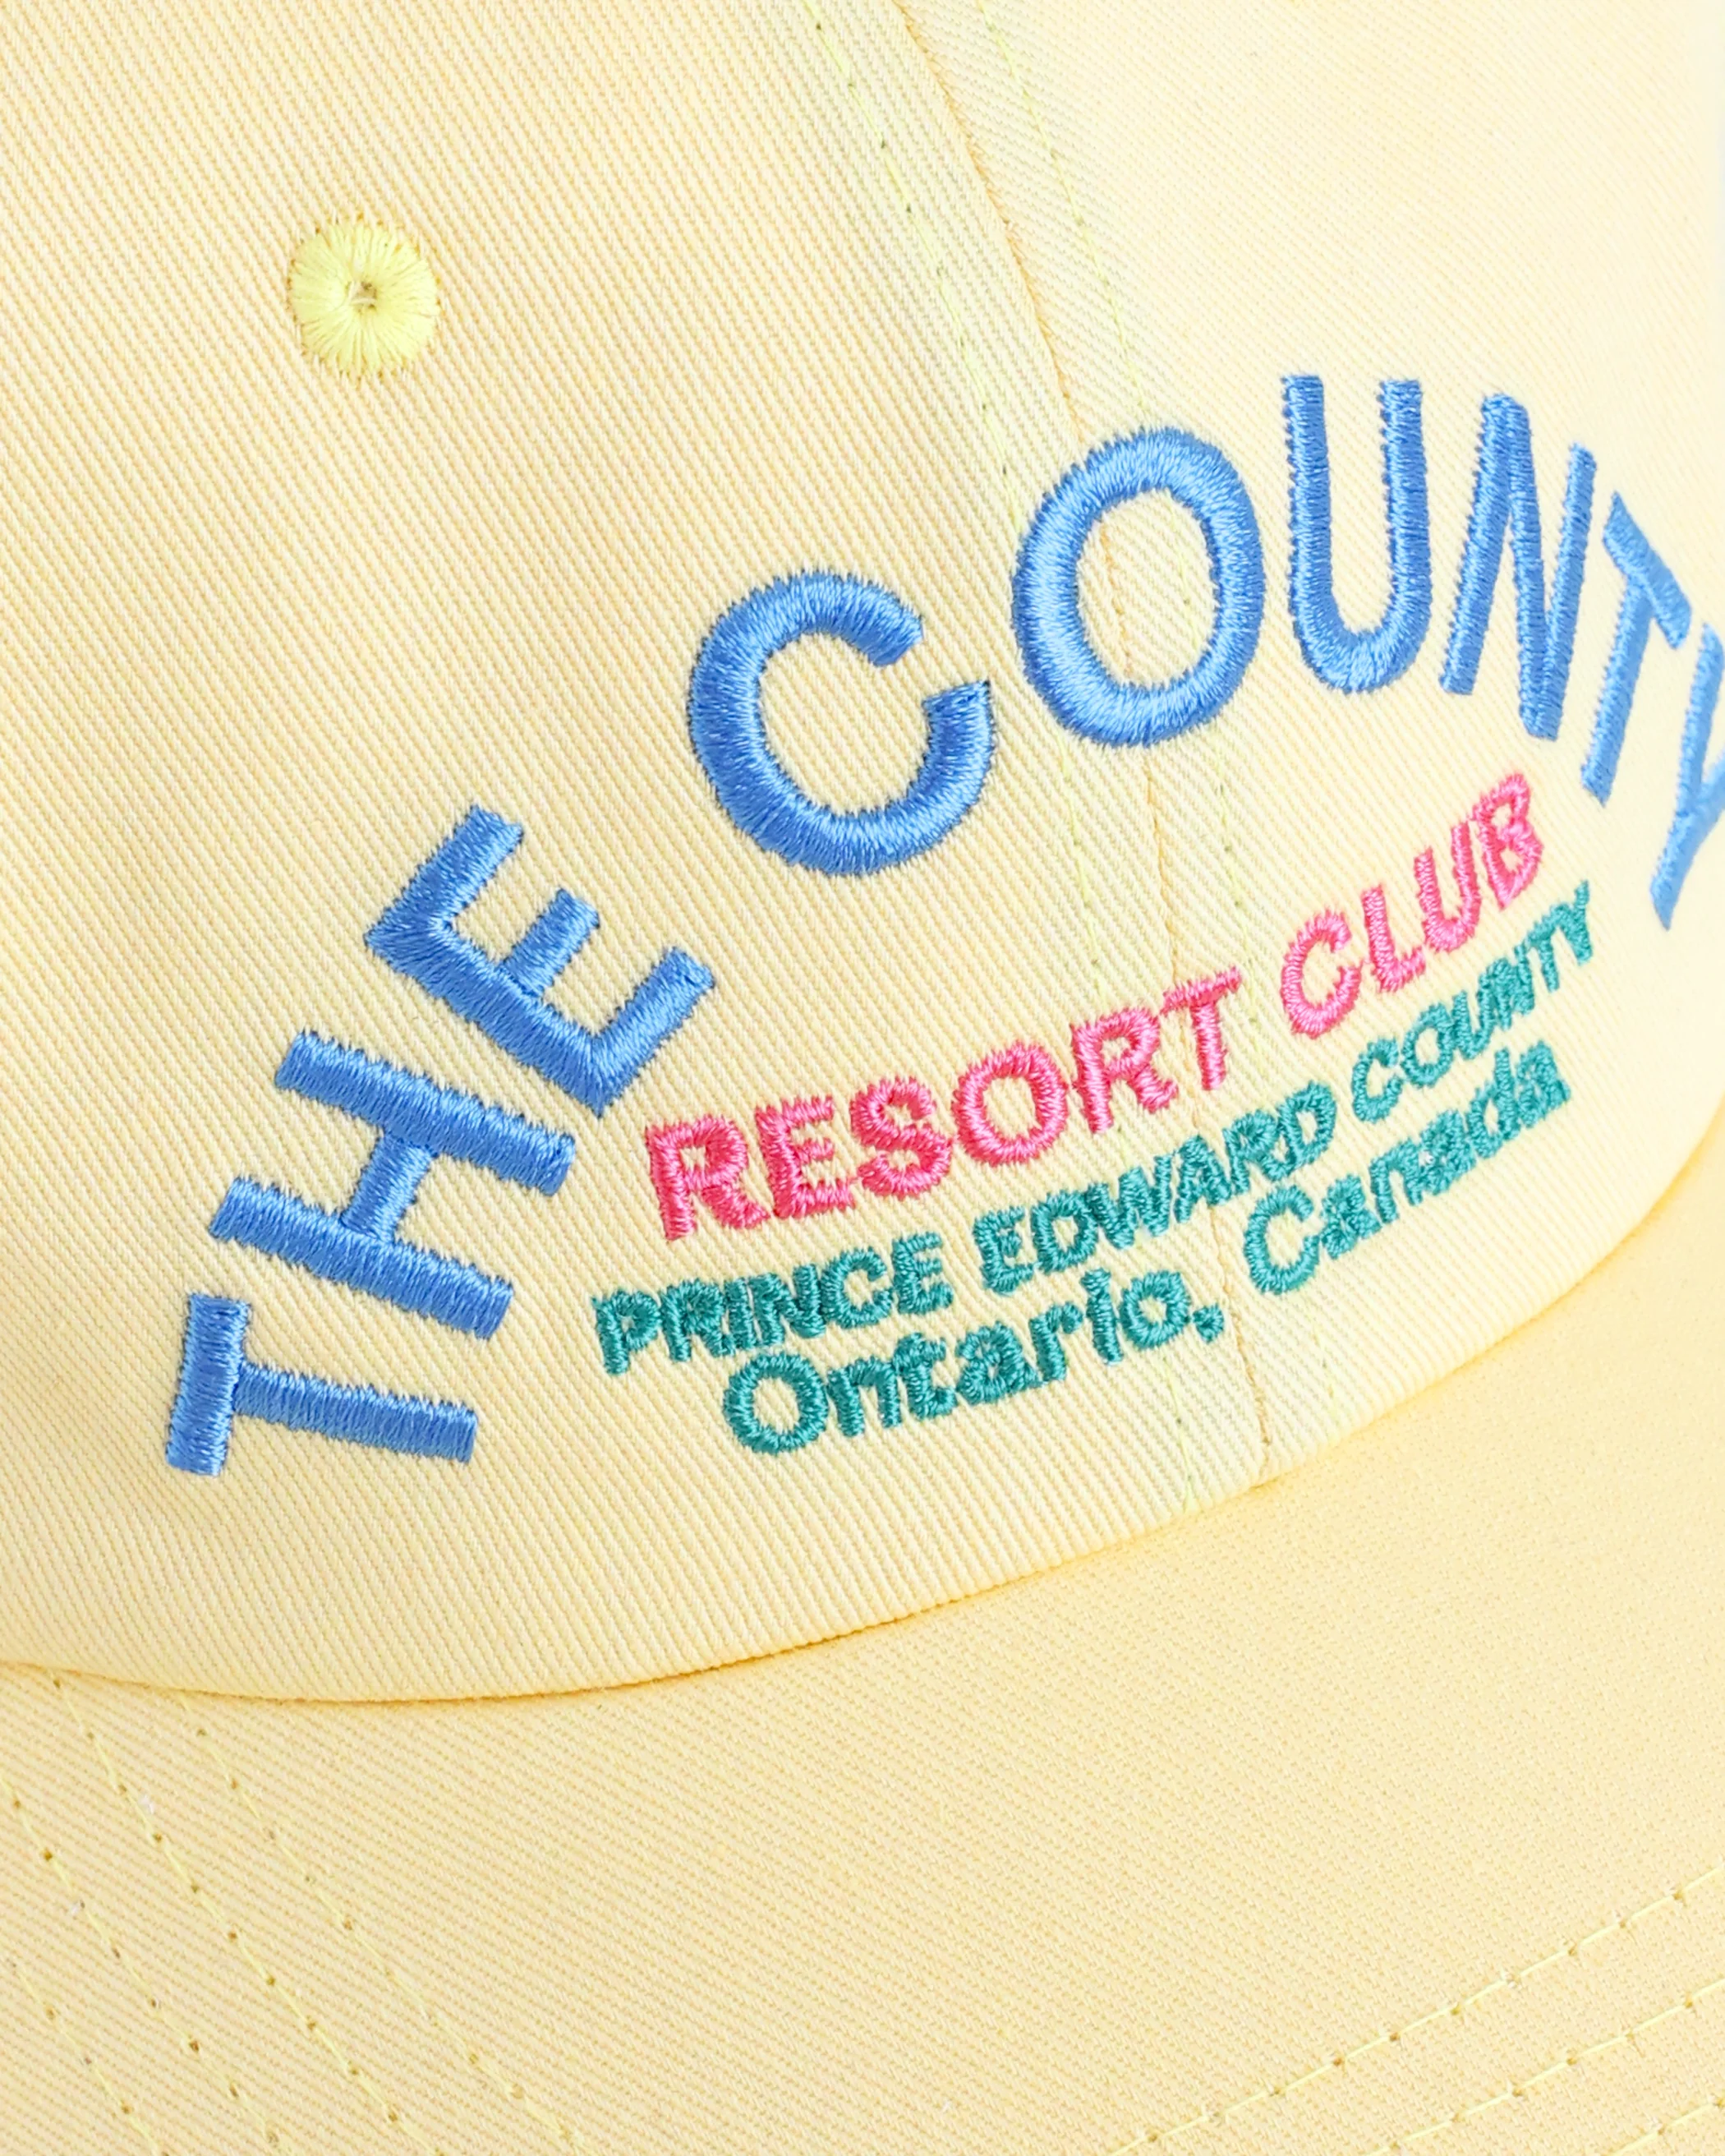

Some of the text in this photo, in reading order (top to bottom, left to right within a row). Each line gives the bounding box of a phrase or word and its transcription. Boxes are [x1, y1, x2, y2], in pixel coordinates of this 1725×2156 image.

[165, 375, 1725, 1476] THE COUNTY
[591, 879, 1594, 1375] PRINCE EDWARD COUNTY
[645, 772, 1544, 1240] RESORT CLUB
[723, 1040, 1571, 1455] Ontario, Canada
